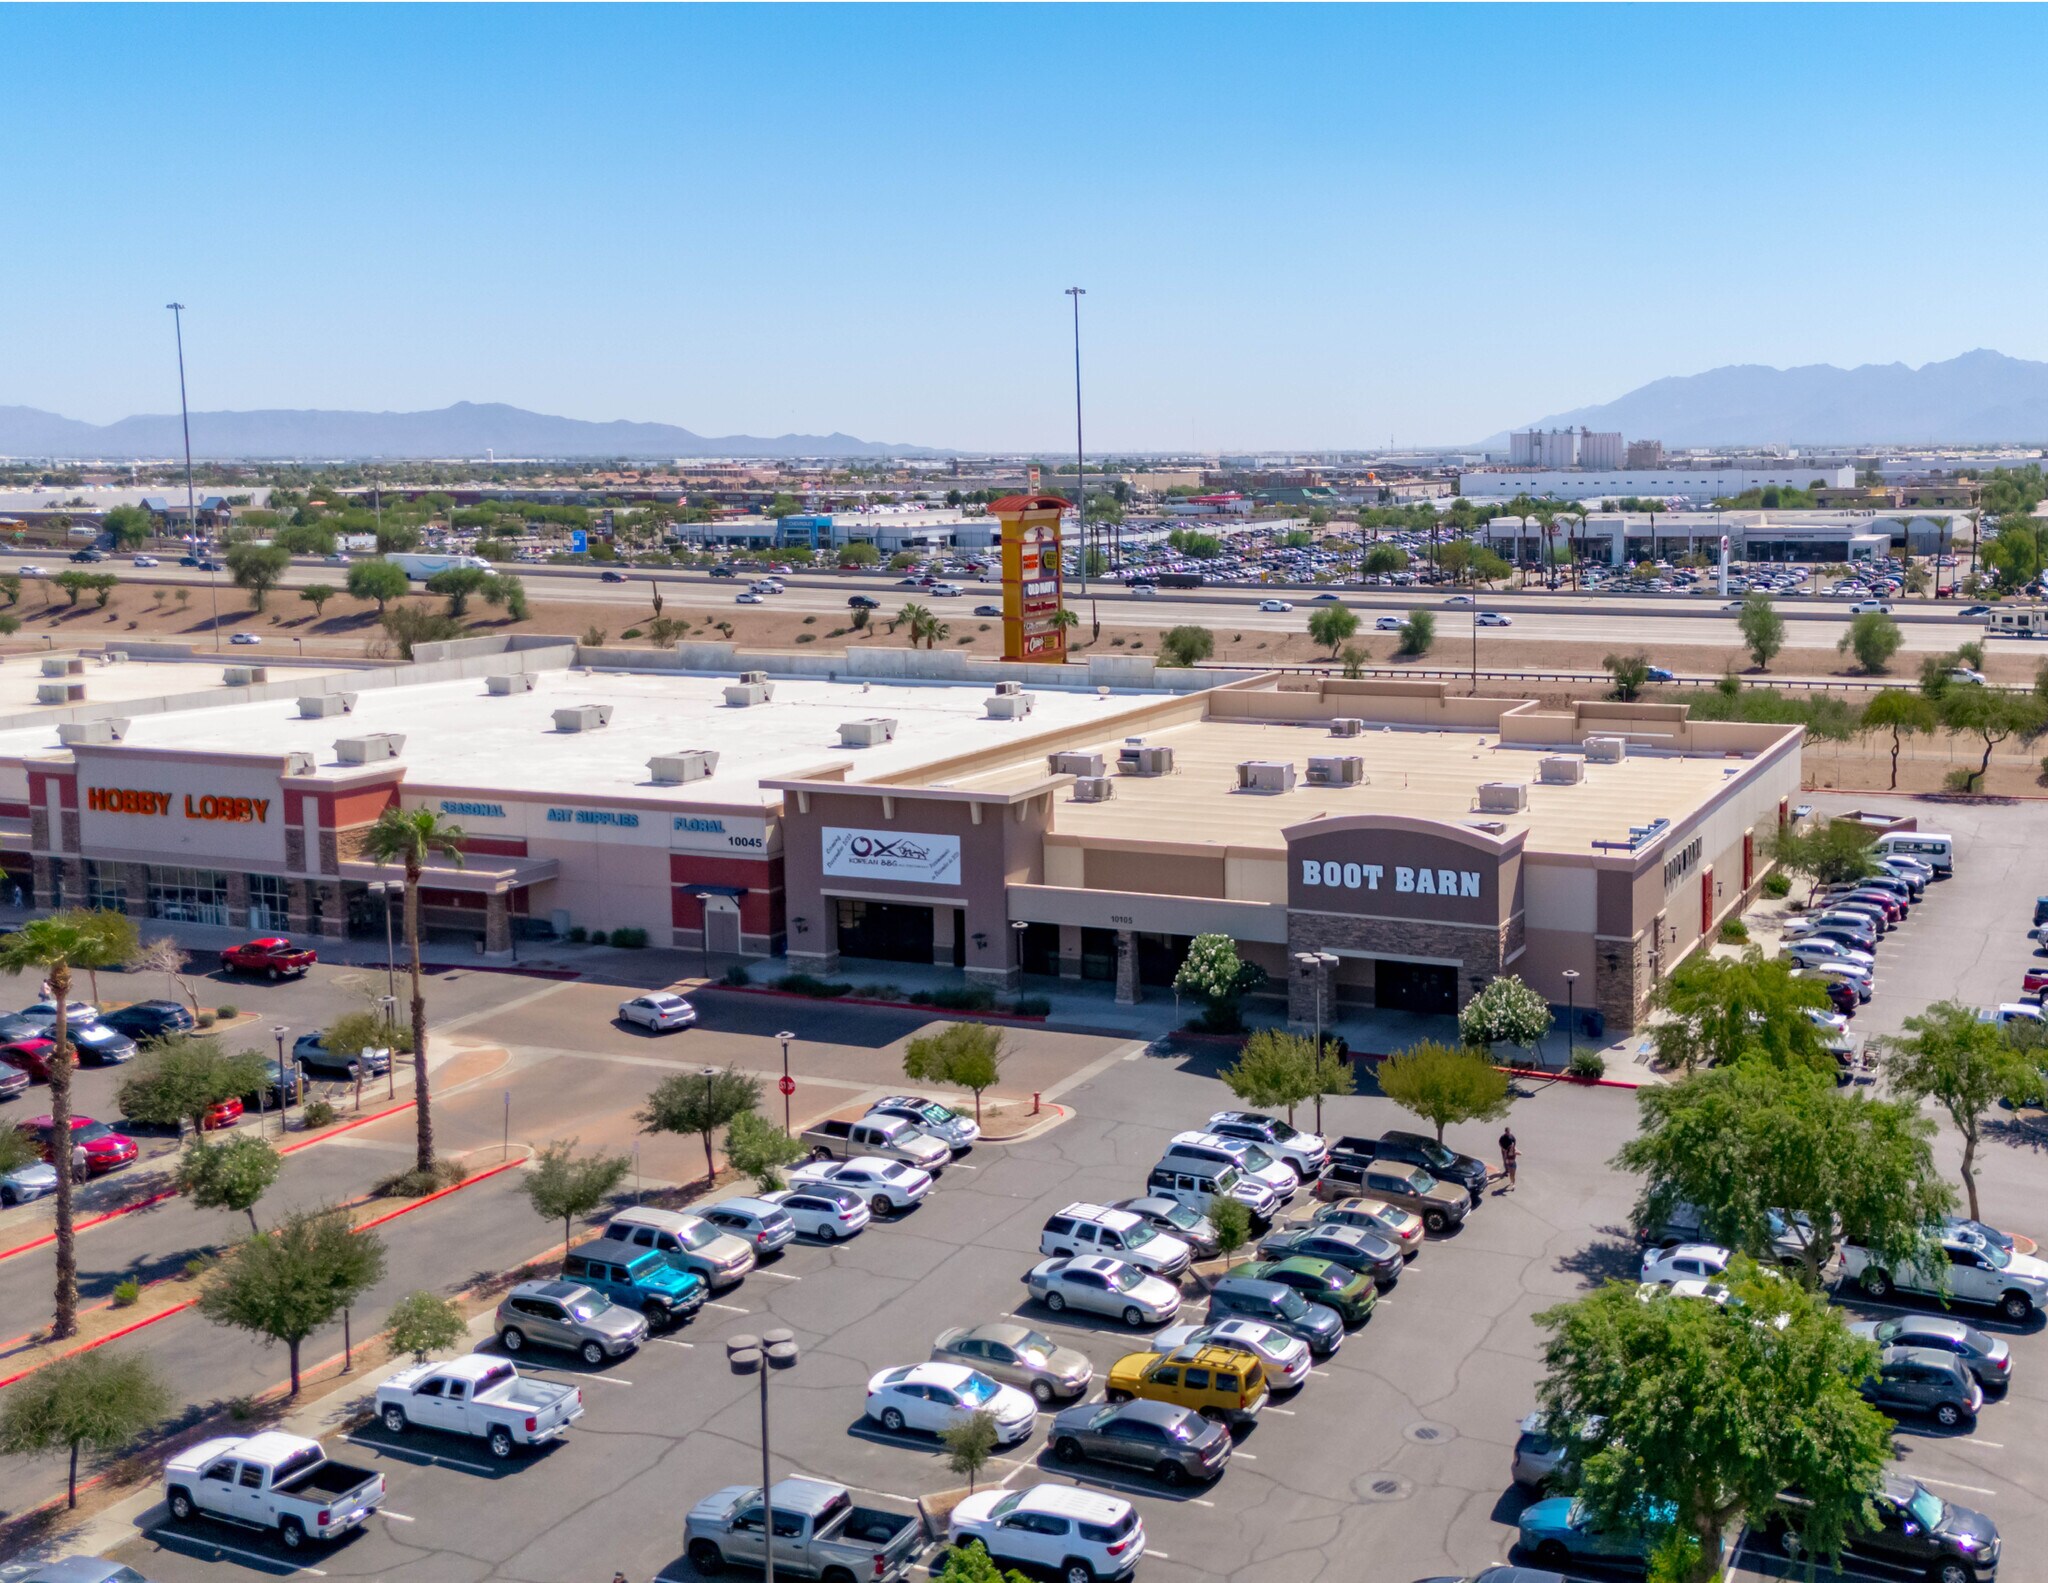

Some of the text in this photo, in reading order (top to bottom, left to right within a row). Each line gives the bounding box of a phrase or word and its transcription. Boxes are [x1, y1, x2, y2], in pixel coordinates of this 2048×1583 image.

[1028, 581, 1055, 596] OLD NAVY
[88, 787, 270, 823] HOBBY LOBBY
[440, 801, 506, 817] SEASONAL
[547, 808, 638, 827] ART SUPPLIES
[674, 817, 726, 833] FLORAL
[728, 836, 762, 848] 10045
[851, 836, 903, 858] OX
[849, 857, 878, 865] KOREAN
[1302, 860, 1480, 898] BOOT BARN
[1111, 915, 1132, 924] 10105
